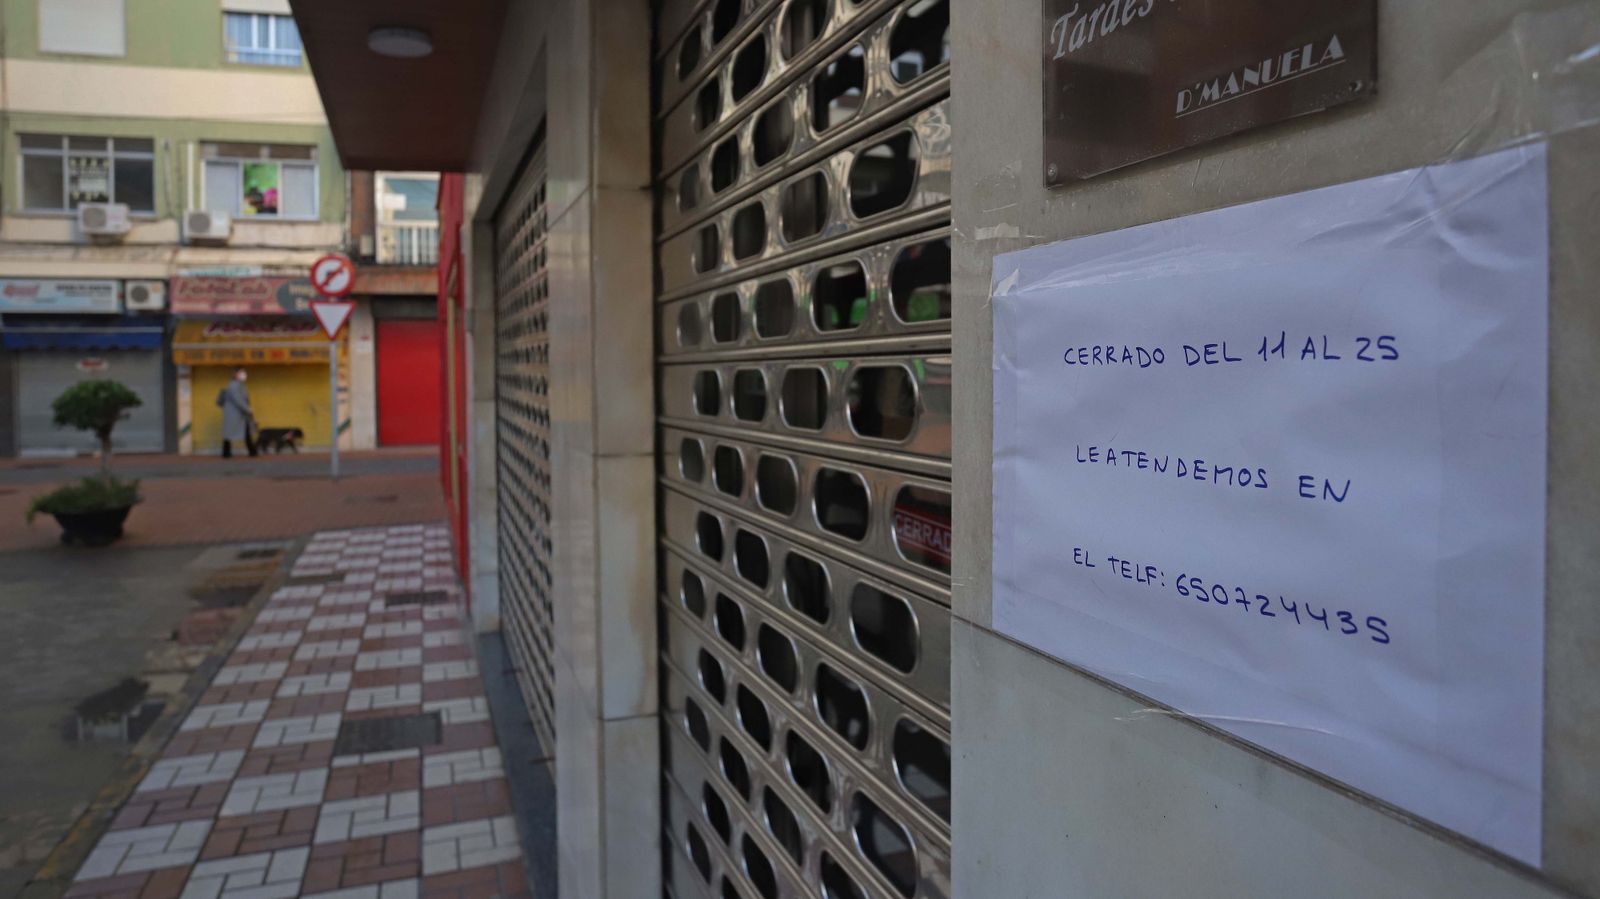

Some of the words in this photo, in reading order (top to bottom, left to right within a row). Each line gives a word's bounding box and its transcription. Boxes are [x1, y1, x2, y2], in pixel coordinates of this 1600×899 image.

[1175, 33, 1345, 115] D'MANUELA
[1063, 345, 1166, 369] CERRADO
[1183, 341, 1243, 367] DEL
[1258, 330, 1287, 363] 11
[1300, 335, 1342, 361] AL
[1356, 335, 1400, 363] 25
[1299, 475, 1351, 503] EN
[1073, 548, 1097, 568] EL
[1107, 555, 1166, 587] TELF:
[1175, 573, 1391, 645] 650724435
